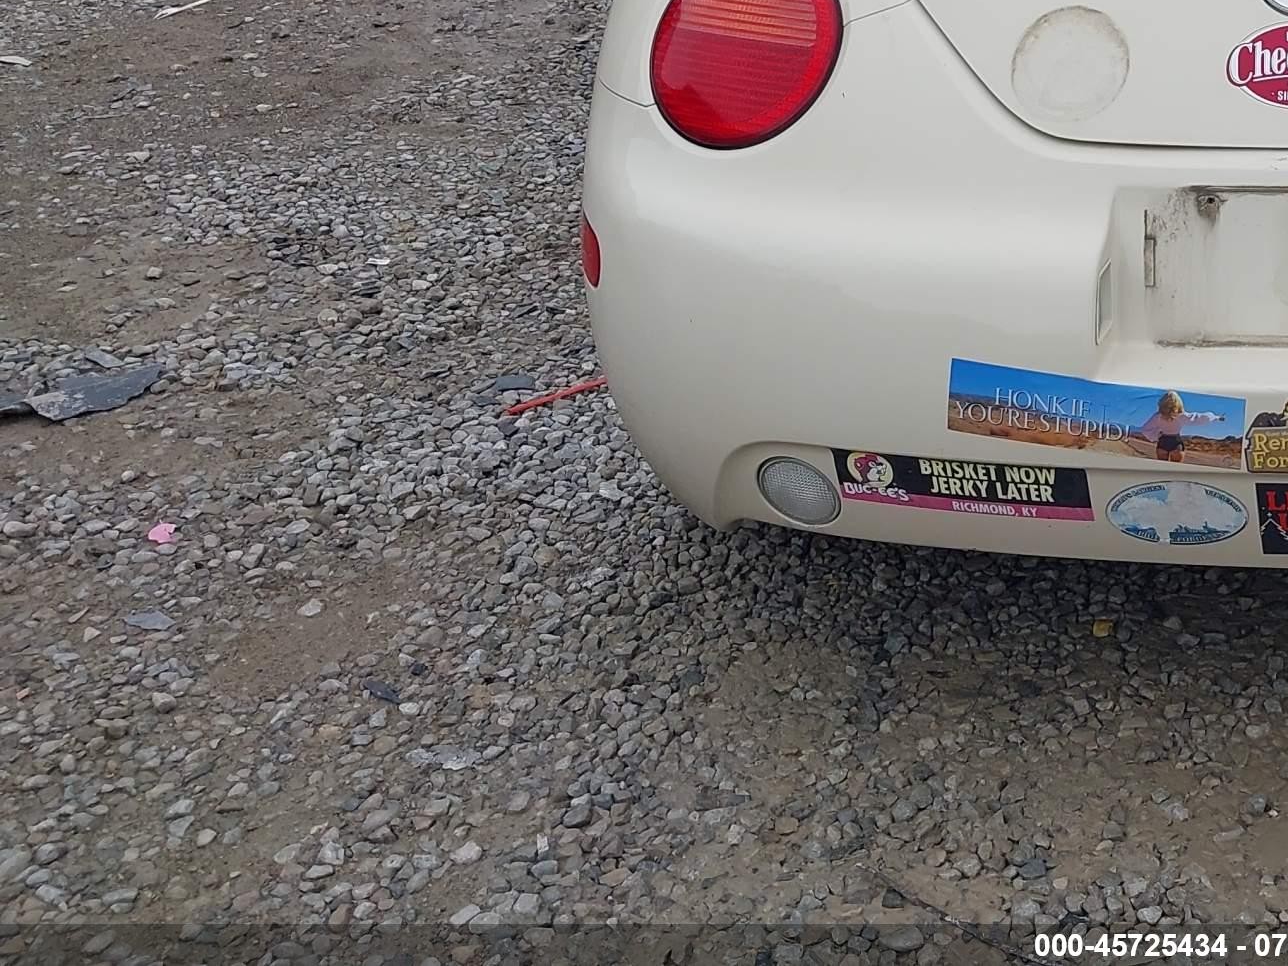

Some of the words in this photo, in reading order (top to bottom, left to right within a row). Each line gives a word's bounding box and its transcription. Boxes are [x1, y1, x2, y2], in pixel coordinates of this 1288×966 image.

[995, 386, 1070, 417] HONK
[1071, 397, 1091, 420] IF
[955, 401, 1037, 430] YOU'RE
[1040, 414, 1130, 442] STUPID!
[918, 459, 998, 481] BRISKET
[1005, 465, 1056, 485] NOW
[930, 475, 989, 498] JERKY
[996, 482, 1055, 503] LATER
[951, 500, 1019, 517] RICHMOND,
[1022, 507, 1039, 518] KY
